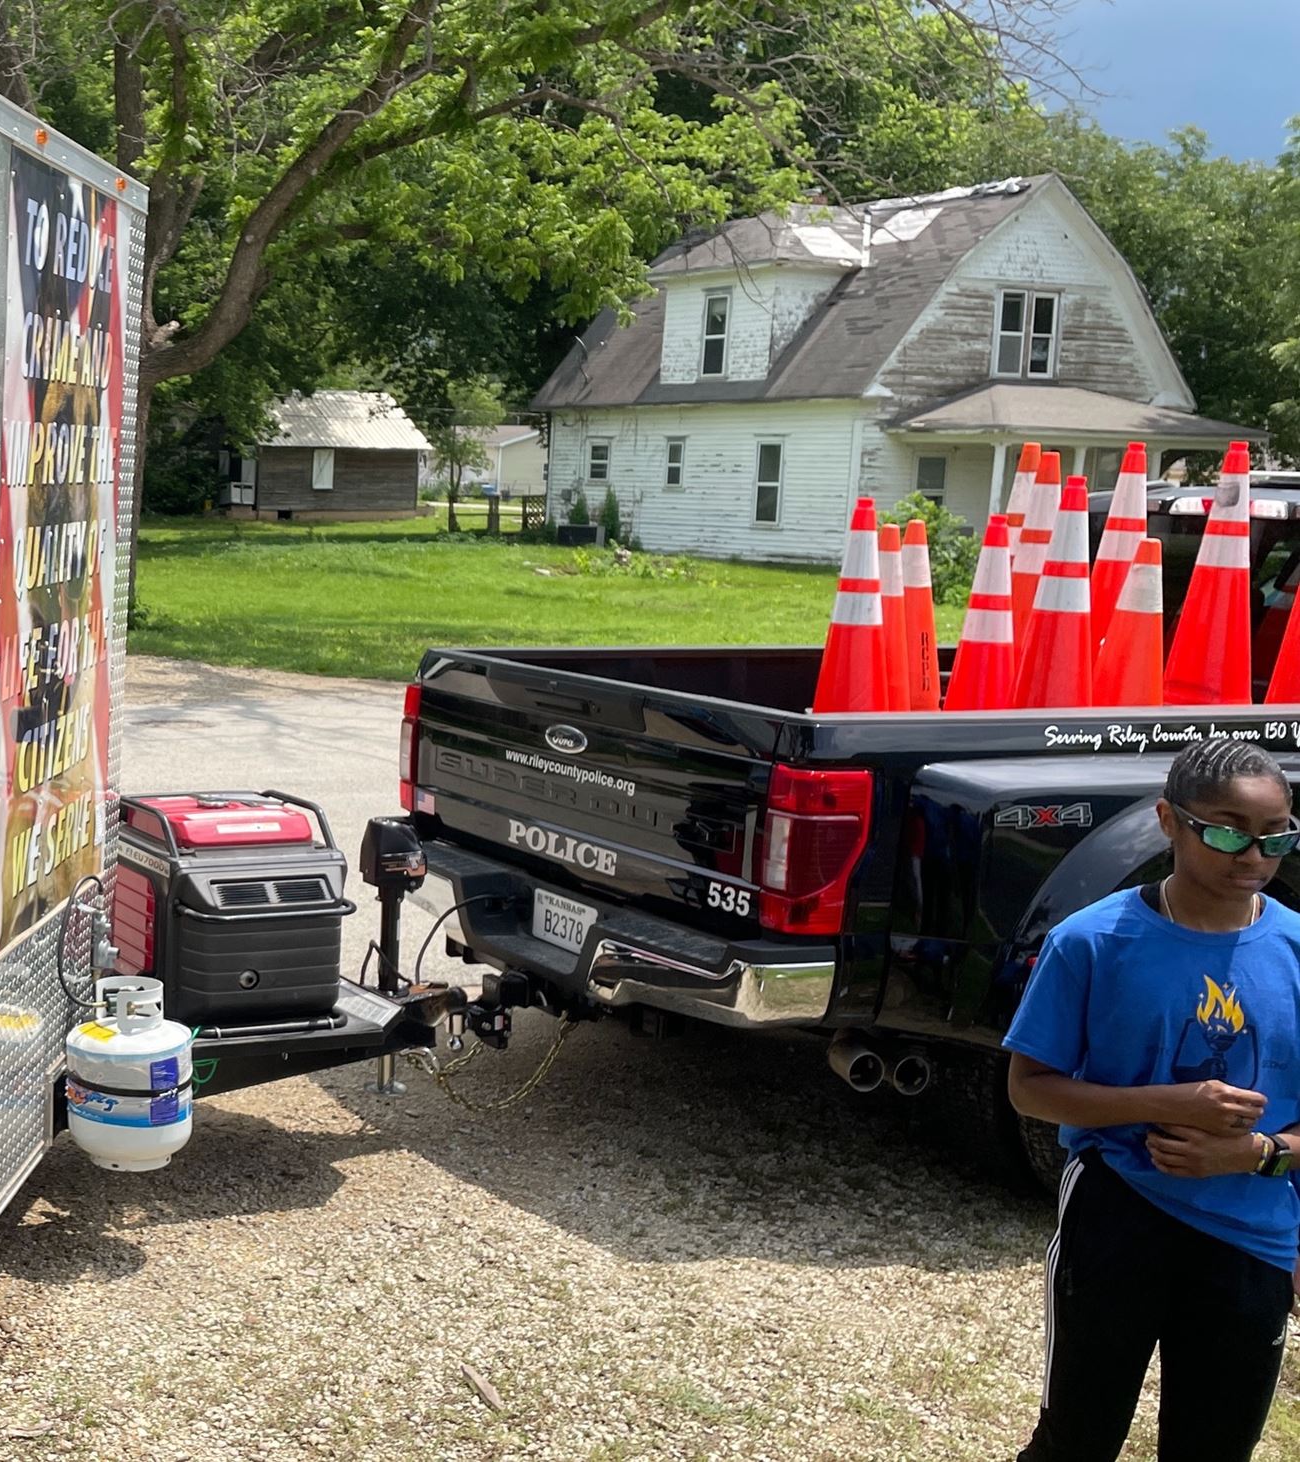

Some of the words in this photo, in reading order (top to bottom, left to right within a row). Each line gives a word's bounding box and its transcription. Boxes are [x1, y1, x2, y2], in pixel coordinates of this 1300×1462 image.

[25, 198, 49, 270] TO
[53, 212, 115, 293] REDUCE
[22, 312, 80, 385] CRIME
[81, 327, 113, 389] AND
[6, 421, 87, 487] IMPROVE
[90, 426, 117, 484] THE
[13, 521, 87, 602] QUALITY
[88, 519, 107, 577] OF
[2, 627, 42, 703] LIFE
[46, 617, 79, 684] FOR
[83, 607, 110, 670] THE
[18, 703, 91, 793] CITIZENS
[1045, 725, 1102, 751] Serving
[1107, 724, 1149, 752] Riley
[1232, 730, 1260, 741] over
[1264, 722, 1287, 740] 150
[439, 751, 577, 805] SUPER
[505, 749, 636, 796] www.rileycountypolice.org
[12, 822, 41, 899] WE
[44, 789, 92, 876] SERVE
[508, 818, 618, 876] POLICE
[544, 909, 584, 945] B2378
[548, 896, 583, 915] KANSAS
[707, 882, 750, 917] 535
